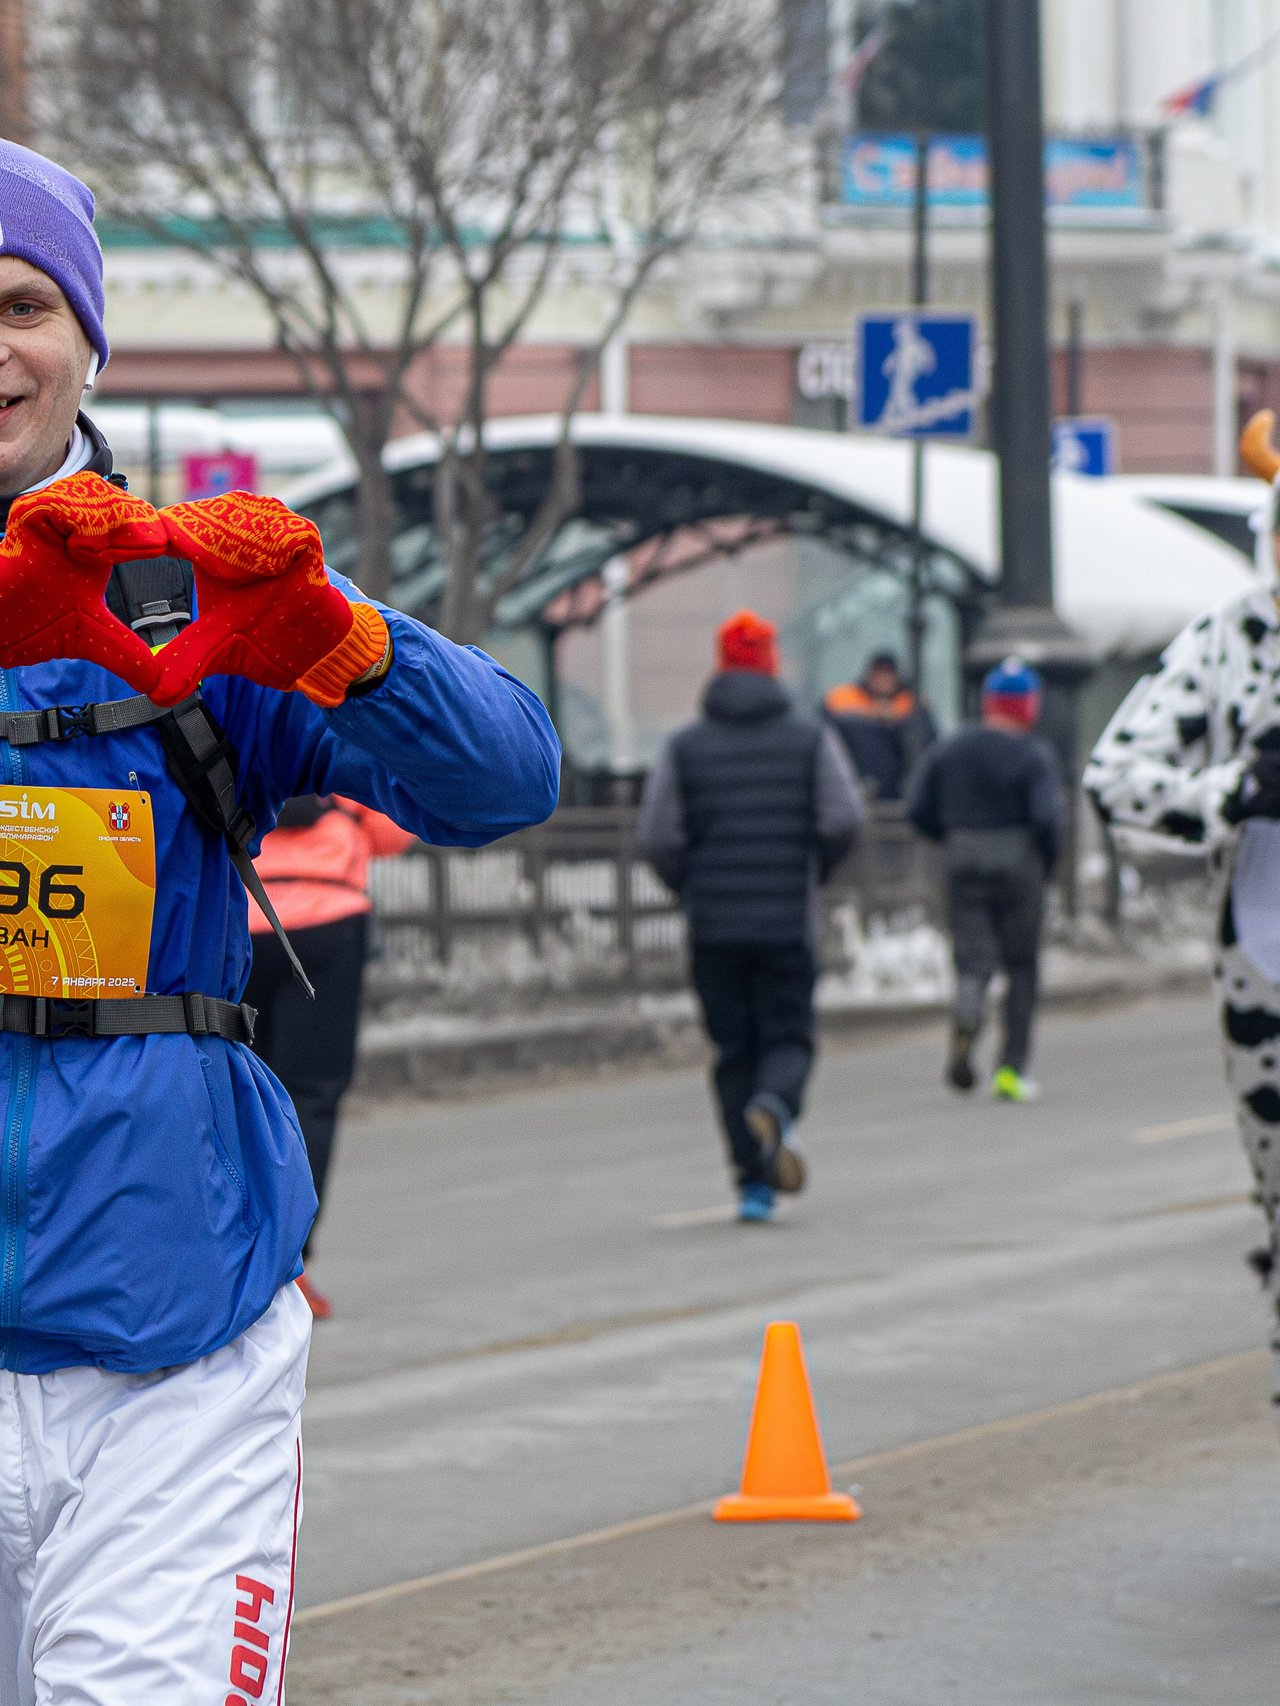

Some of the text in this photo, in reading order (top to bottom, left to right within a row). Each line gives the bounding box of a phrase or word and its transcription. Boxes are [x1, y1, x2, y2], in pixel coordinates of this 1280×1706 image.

[50, 976, 136, 987] 7 ЯНВАРЯ 2025
[224, 1574, 275, 1706] 014
